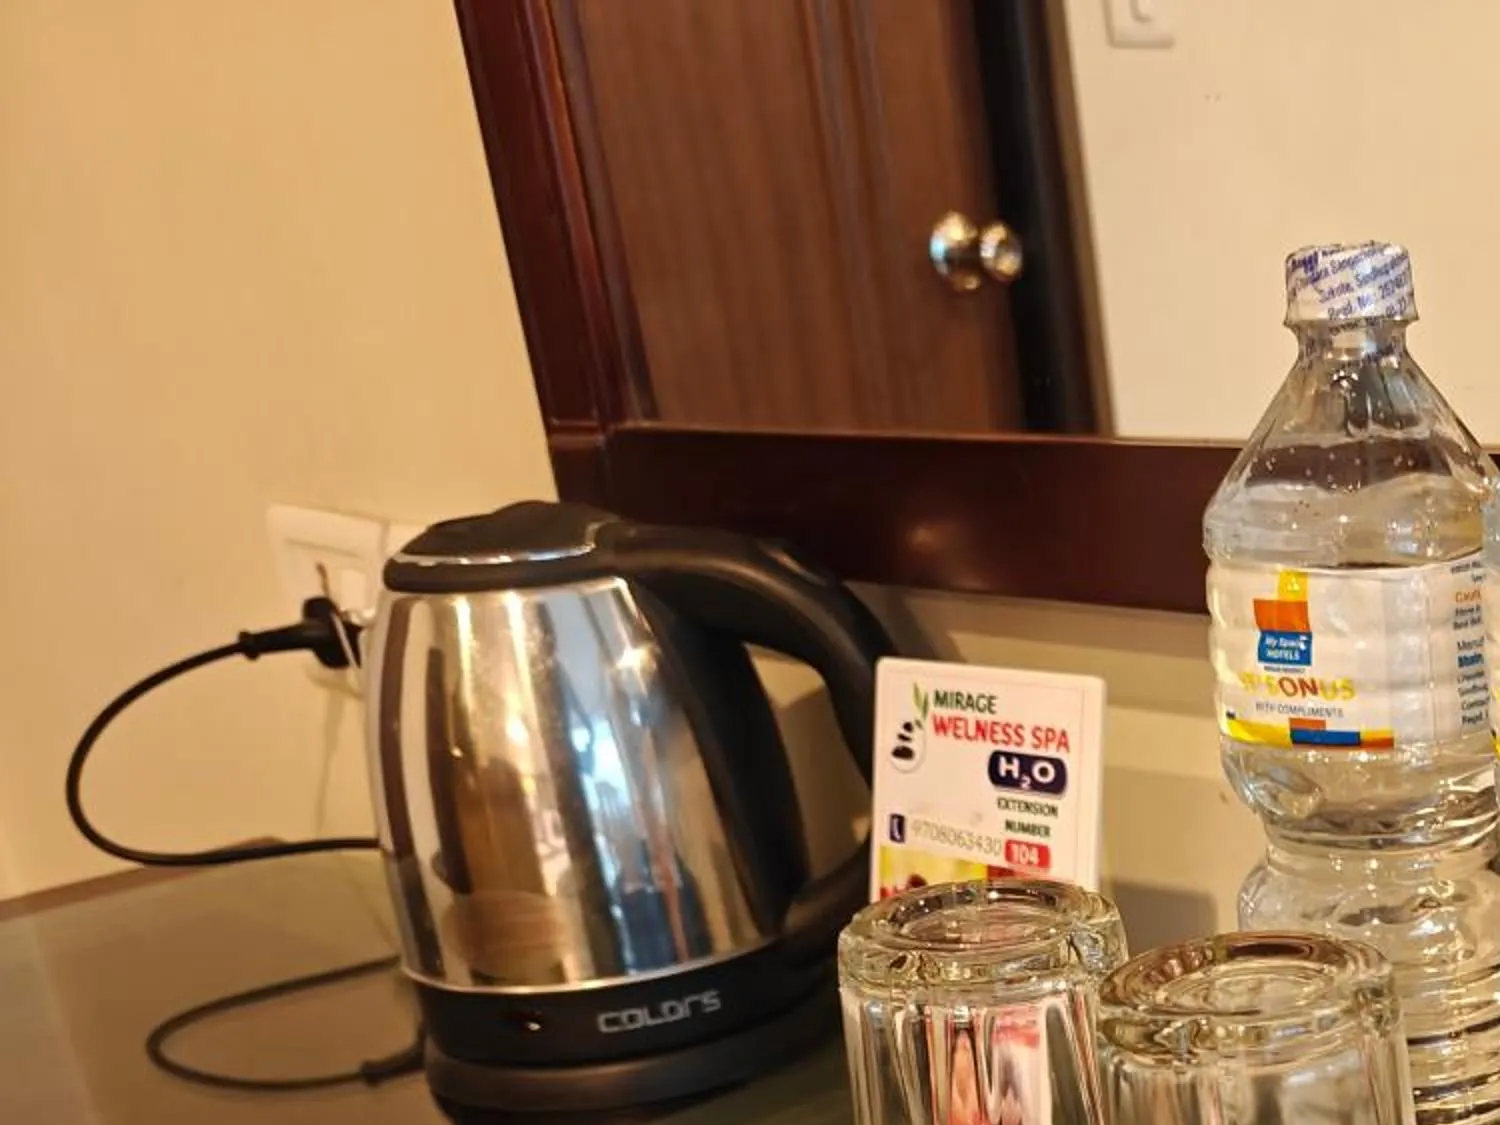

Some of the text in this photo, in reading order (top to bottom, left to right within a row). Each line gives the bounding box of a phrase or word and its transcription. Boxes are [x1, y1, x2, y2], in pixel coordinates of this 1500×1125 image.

[932, 689, 998, 714] MIRAGE
[931, 714, 1072, 754] WELNESS SPA
[997, 797, 1060, 818] EXTENSION
[1004, 820, 1052, 838] NUMBER
